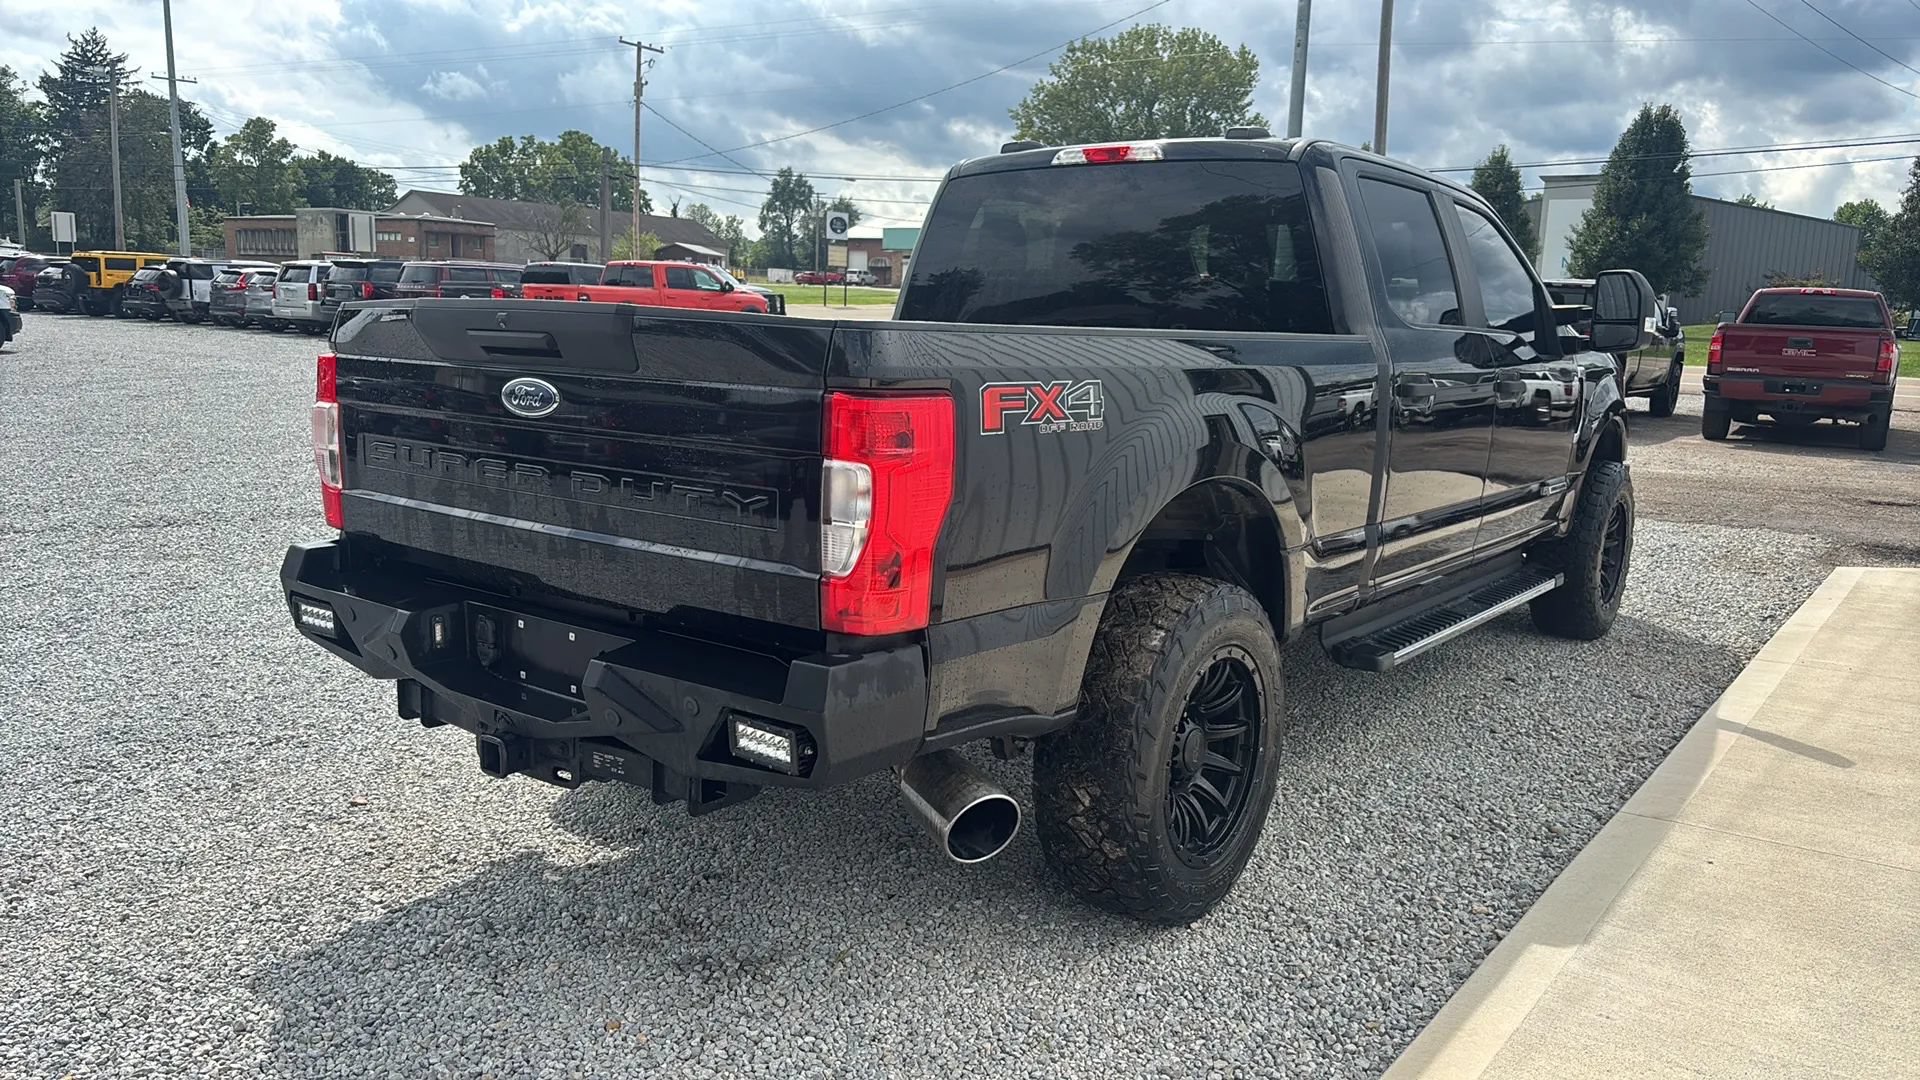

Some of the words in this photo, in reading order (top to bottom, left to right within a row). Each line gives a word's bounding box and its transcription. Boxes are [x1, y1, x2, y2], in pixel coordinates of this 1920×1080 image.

[1782, 348, 1817, 357] GMC
[511, 384, 543, 407] Ford
[980, 380, 1104, 435] FX4
[1039, 423, 1066, 434] OFF
[1069, 421, 1104, 432] ROAD
[368, 440, 551, 487] SUPER
[571, 470, 770, 518] DUTY
